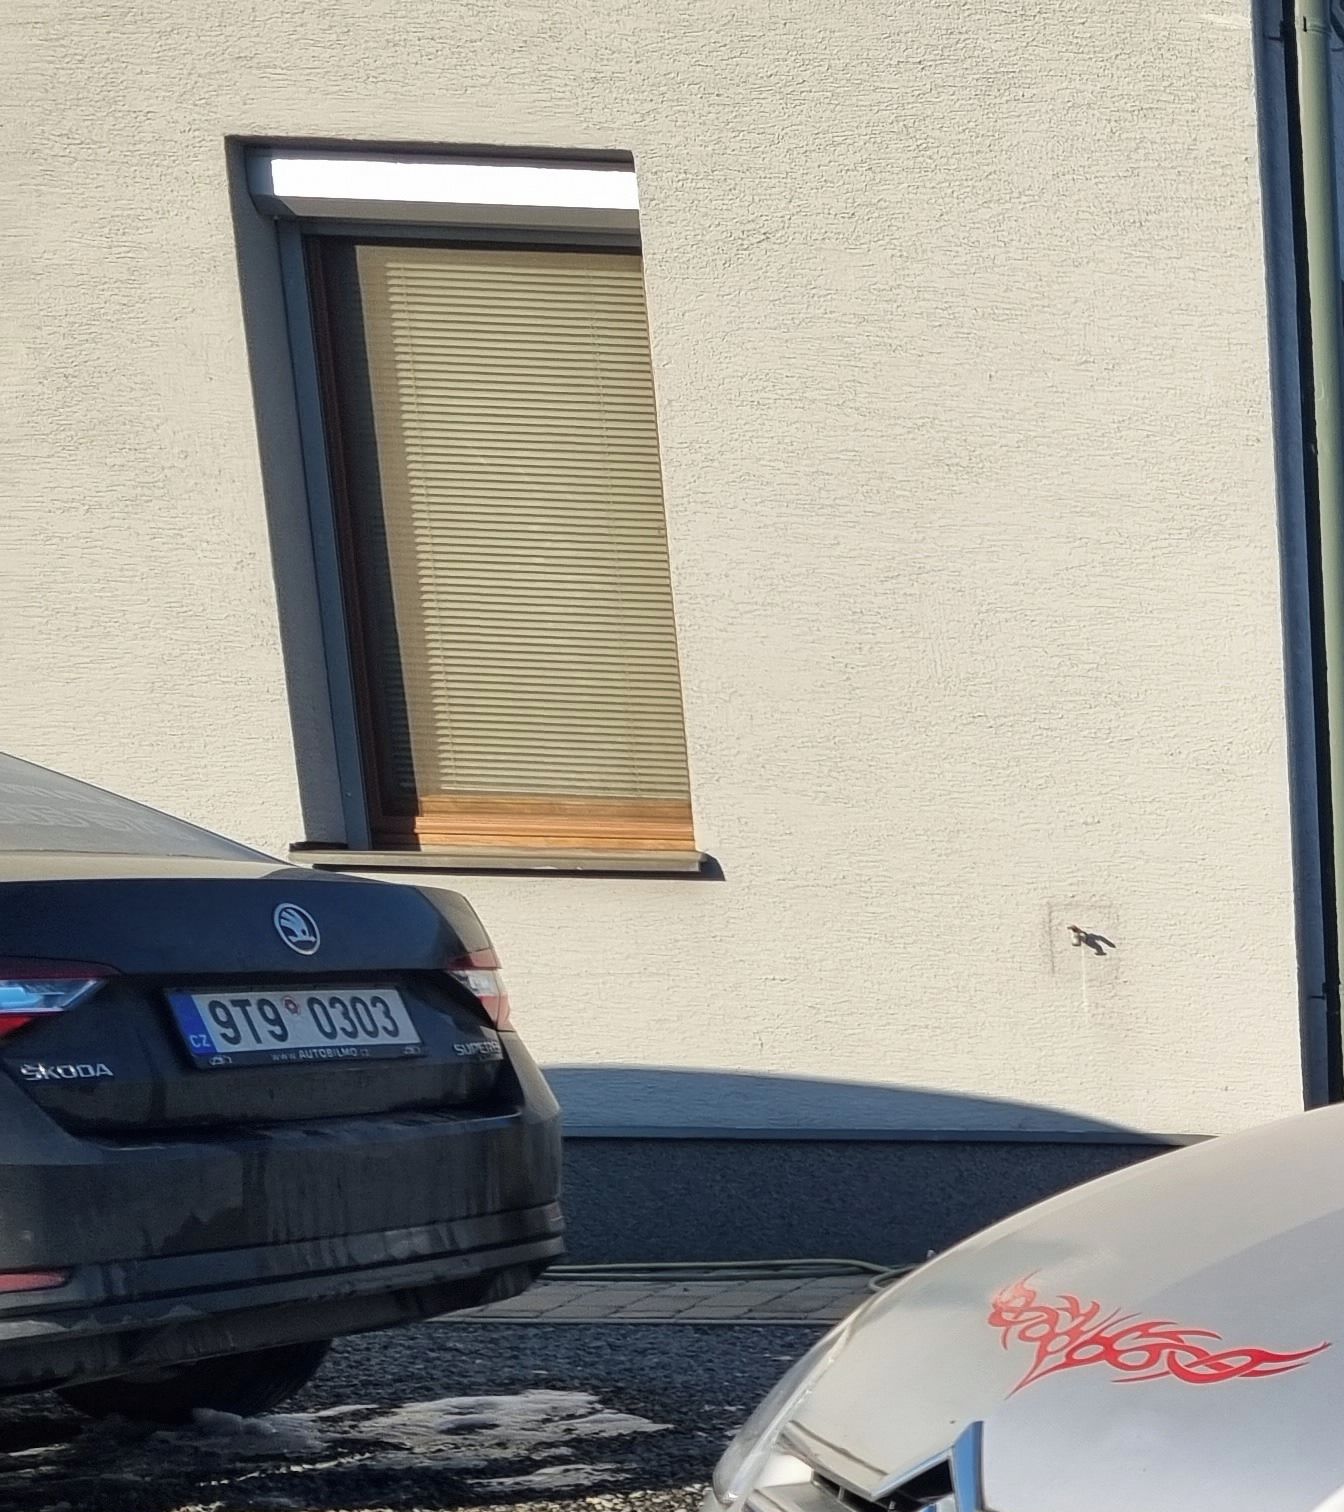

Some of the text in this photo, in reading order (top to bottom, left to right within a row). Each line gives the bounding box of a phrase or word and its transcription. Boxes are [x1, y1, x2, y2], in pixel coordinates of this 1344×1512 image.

[208, 996, 400, 1045] 9T9 0303
[190, 1034, 211, 1049] CZ
